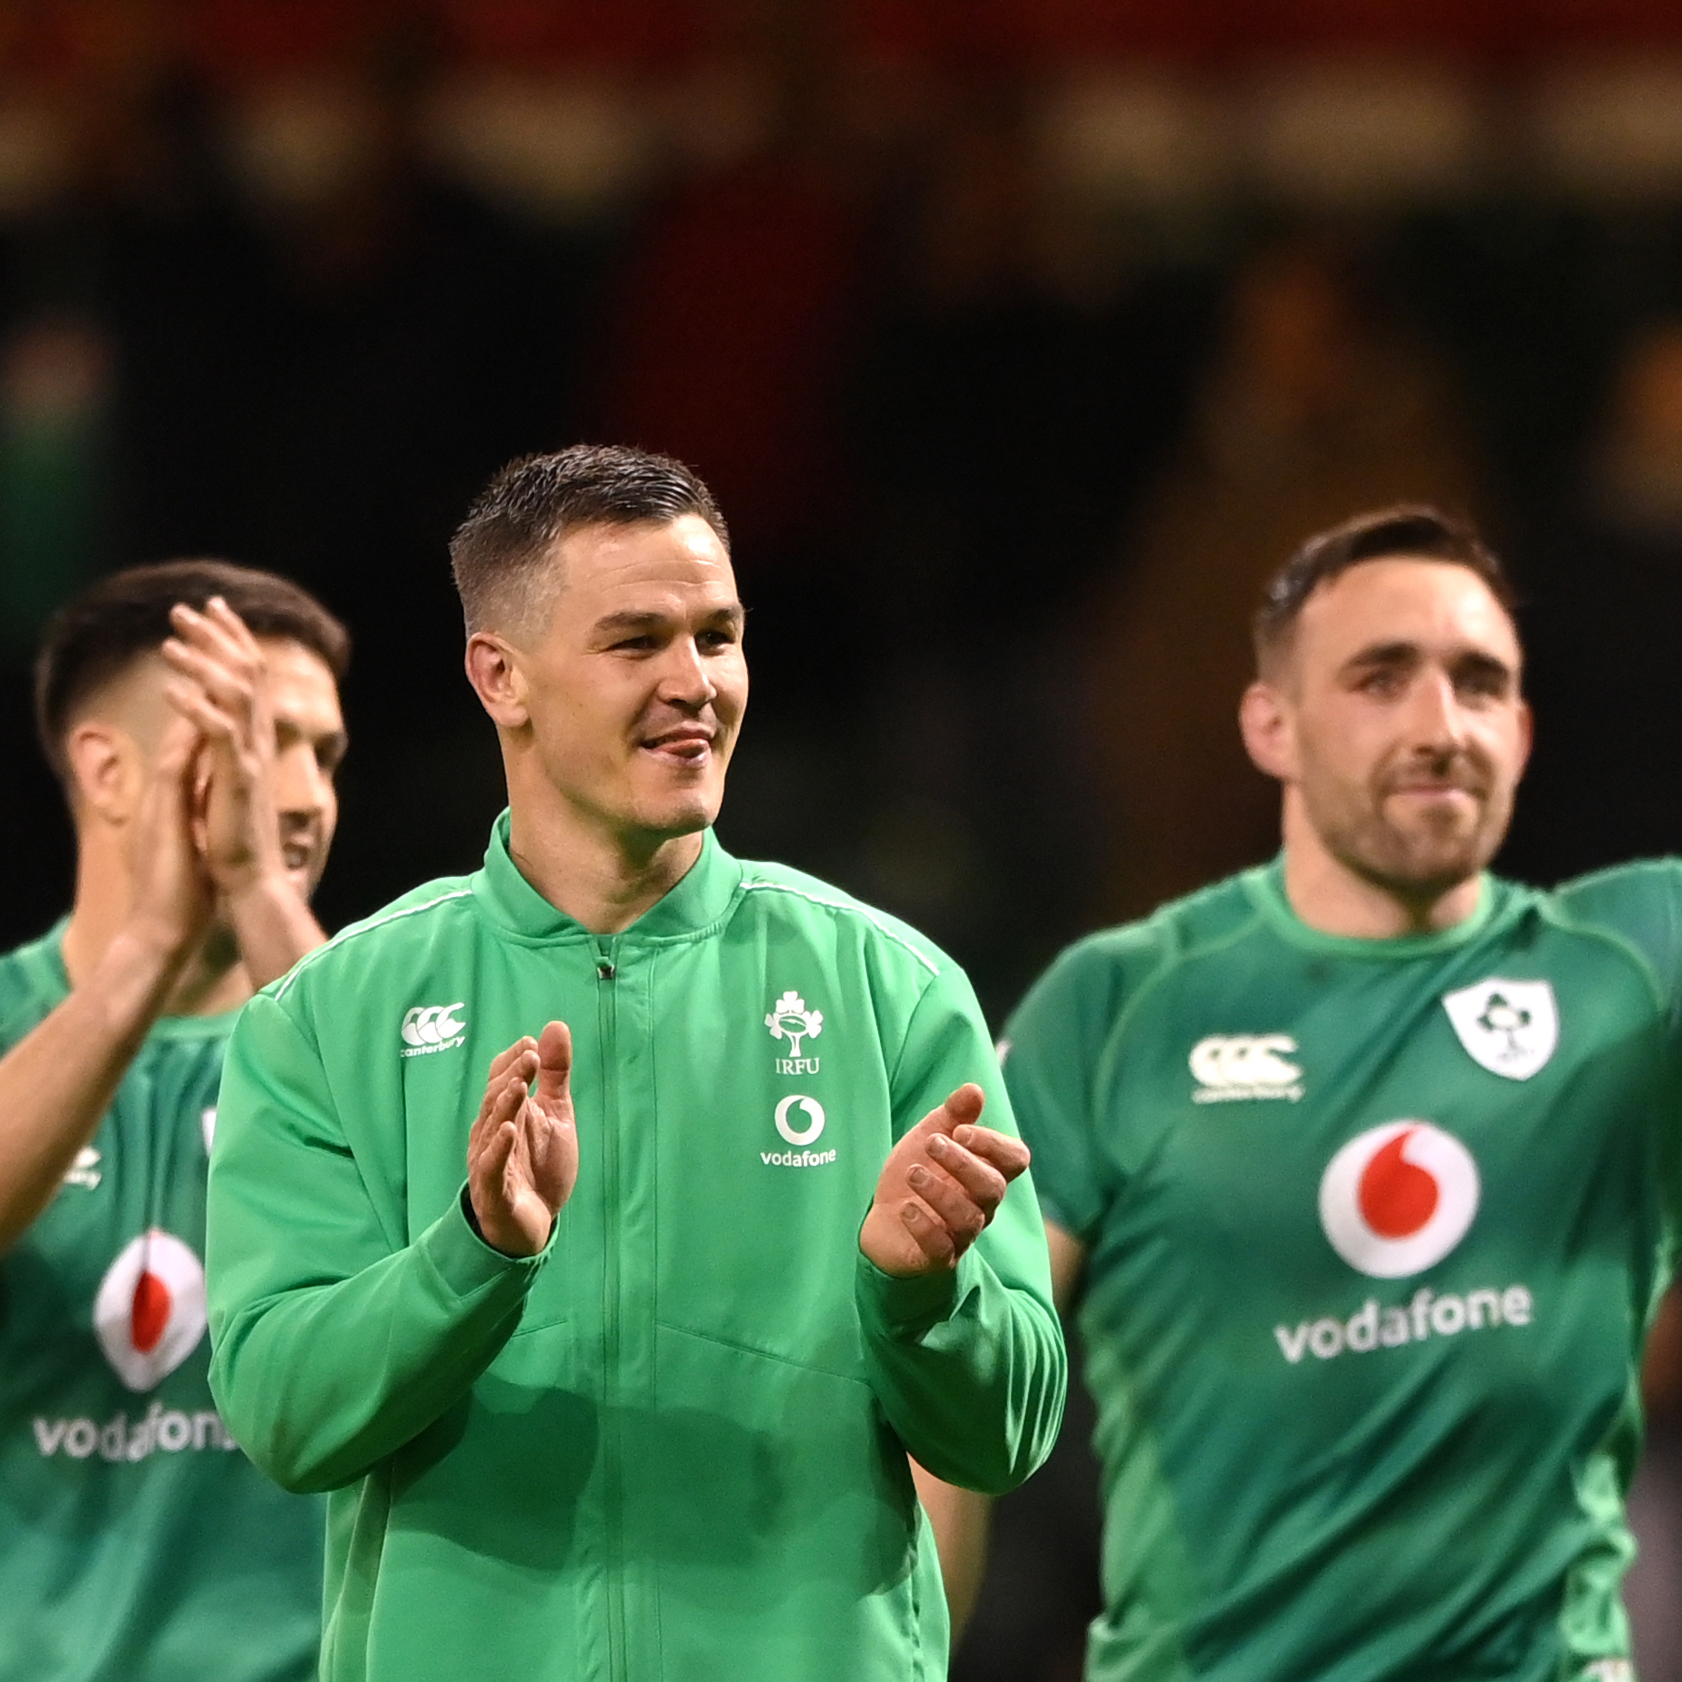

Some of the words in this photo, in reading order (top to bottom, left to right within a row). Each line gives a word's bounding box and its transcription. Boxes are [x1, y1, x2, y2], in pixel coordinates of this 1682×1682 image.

[775, 1057, 820, 1075] IRFU
[760, 1149, 837, 1168] vodafone
[1274, 1283, 1534, 1363] vodafone
[32, 1402, 237, 1462] vodafon
